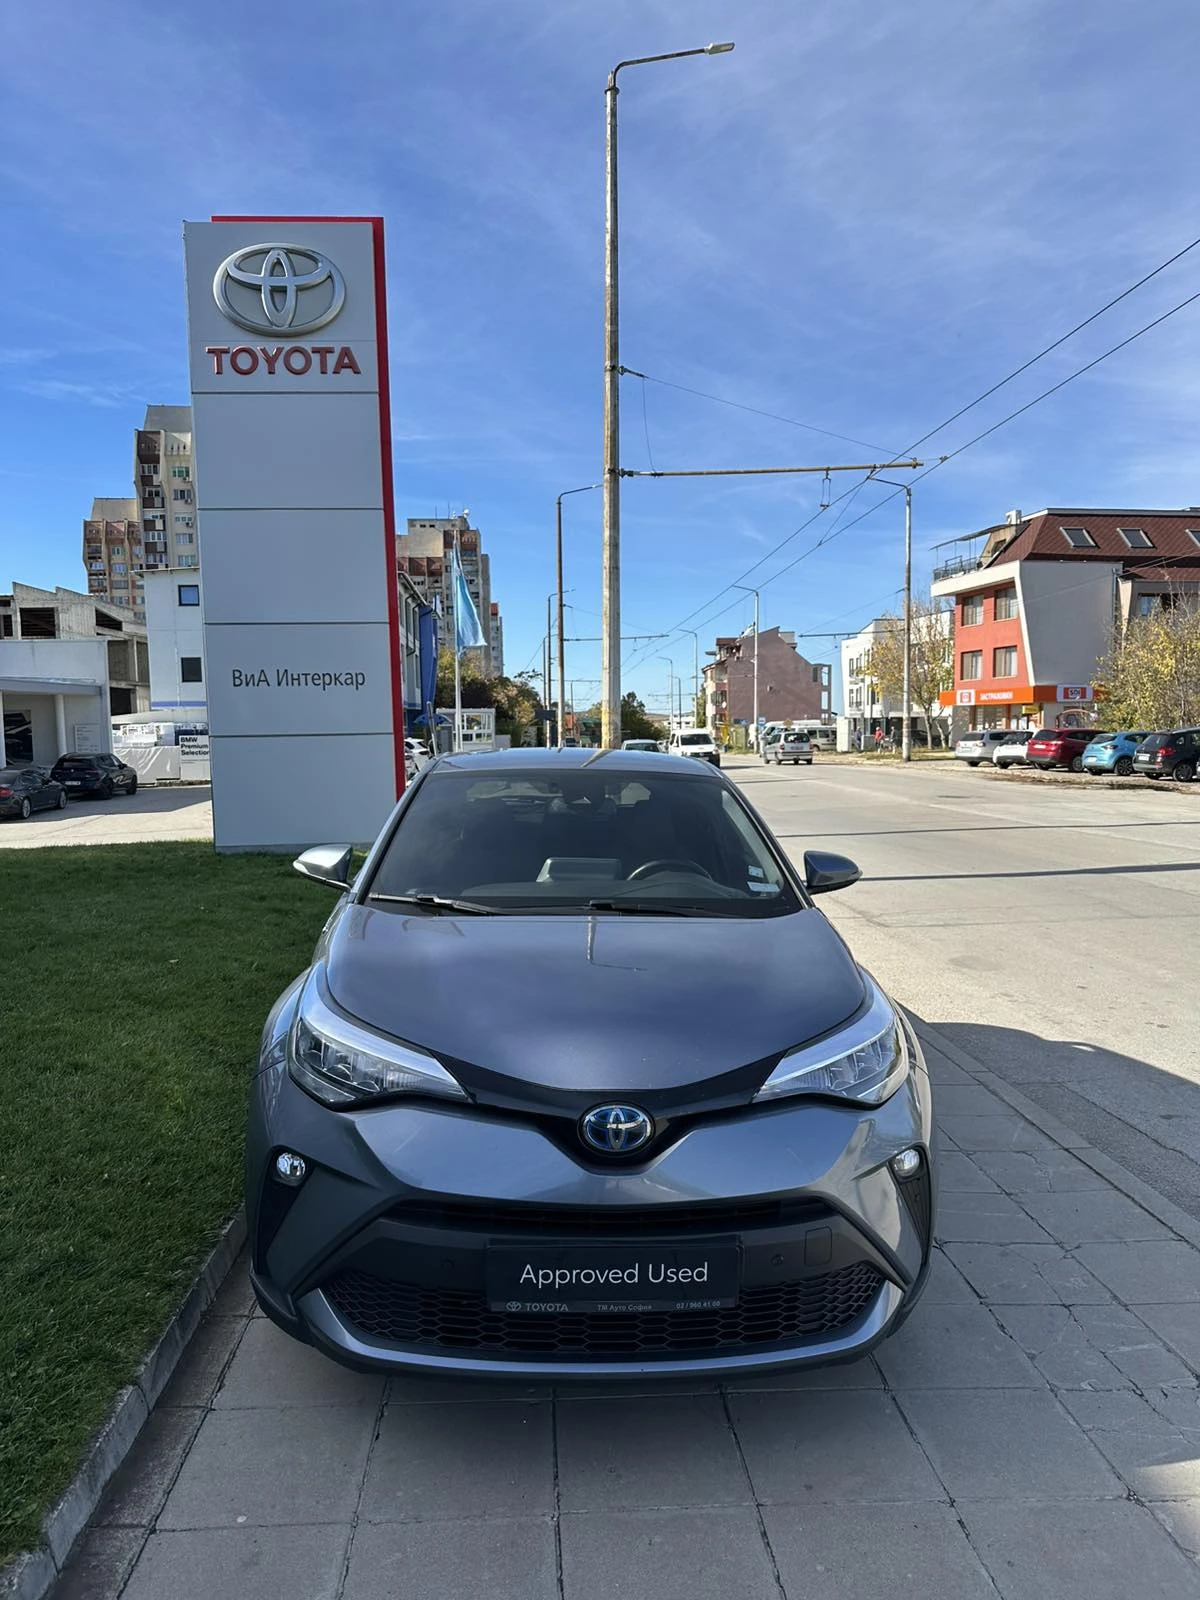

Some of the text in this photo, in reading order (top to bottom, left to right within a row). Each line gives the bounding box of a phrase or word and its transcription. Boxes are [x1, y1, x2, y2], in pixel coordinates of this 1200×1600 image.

[205, 345, 362, 376] TOYOTA
[232, 668, 367, 692] ВиА Интеркар
[519, 1261, 708, 1289] Approved Used
[525, 1303, 569, 1313] TOYOTA
[608, 1304, 627, 1312] Ауто
[627, 1303, 653, 1312] София
